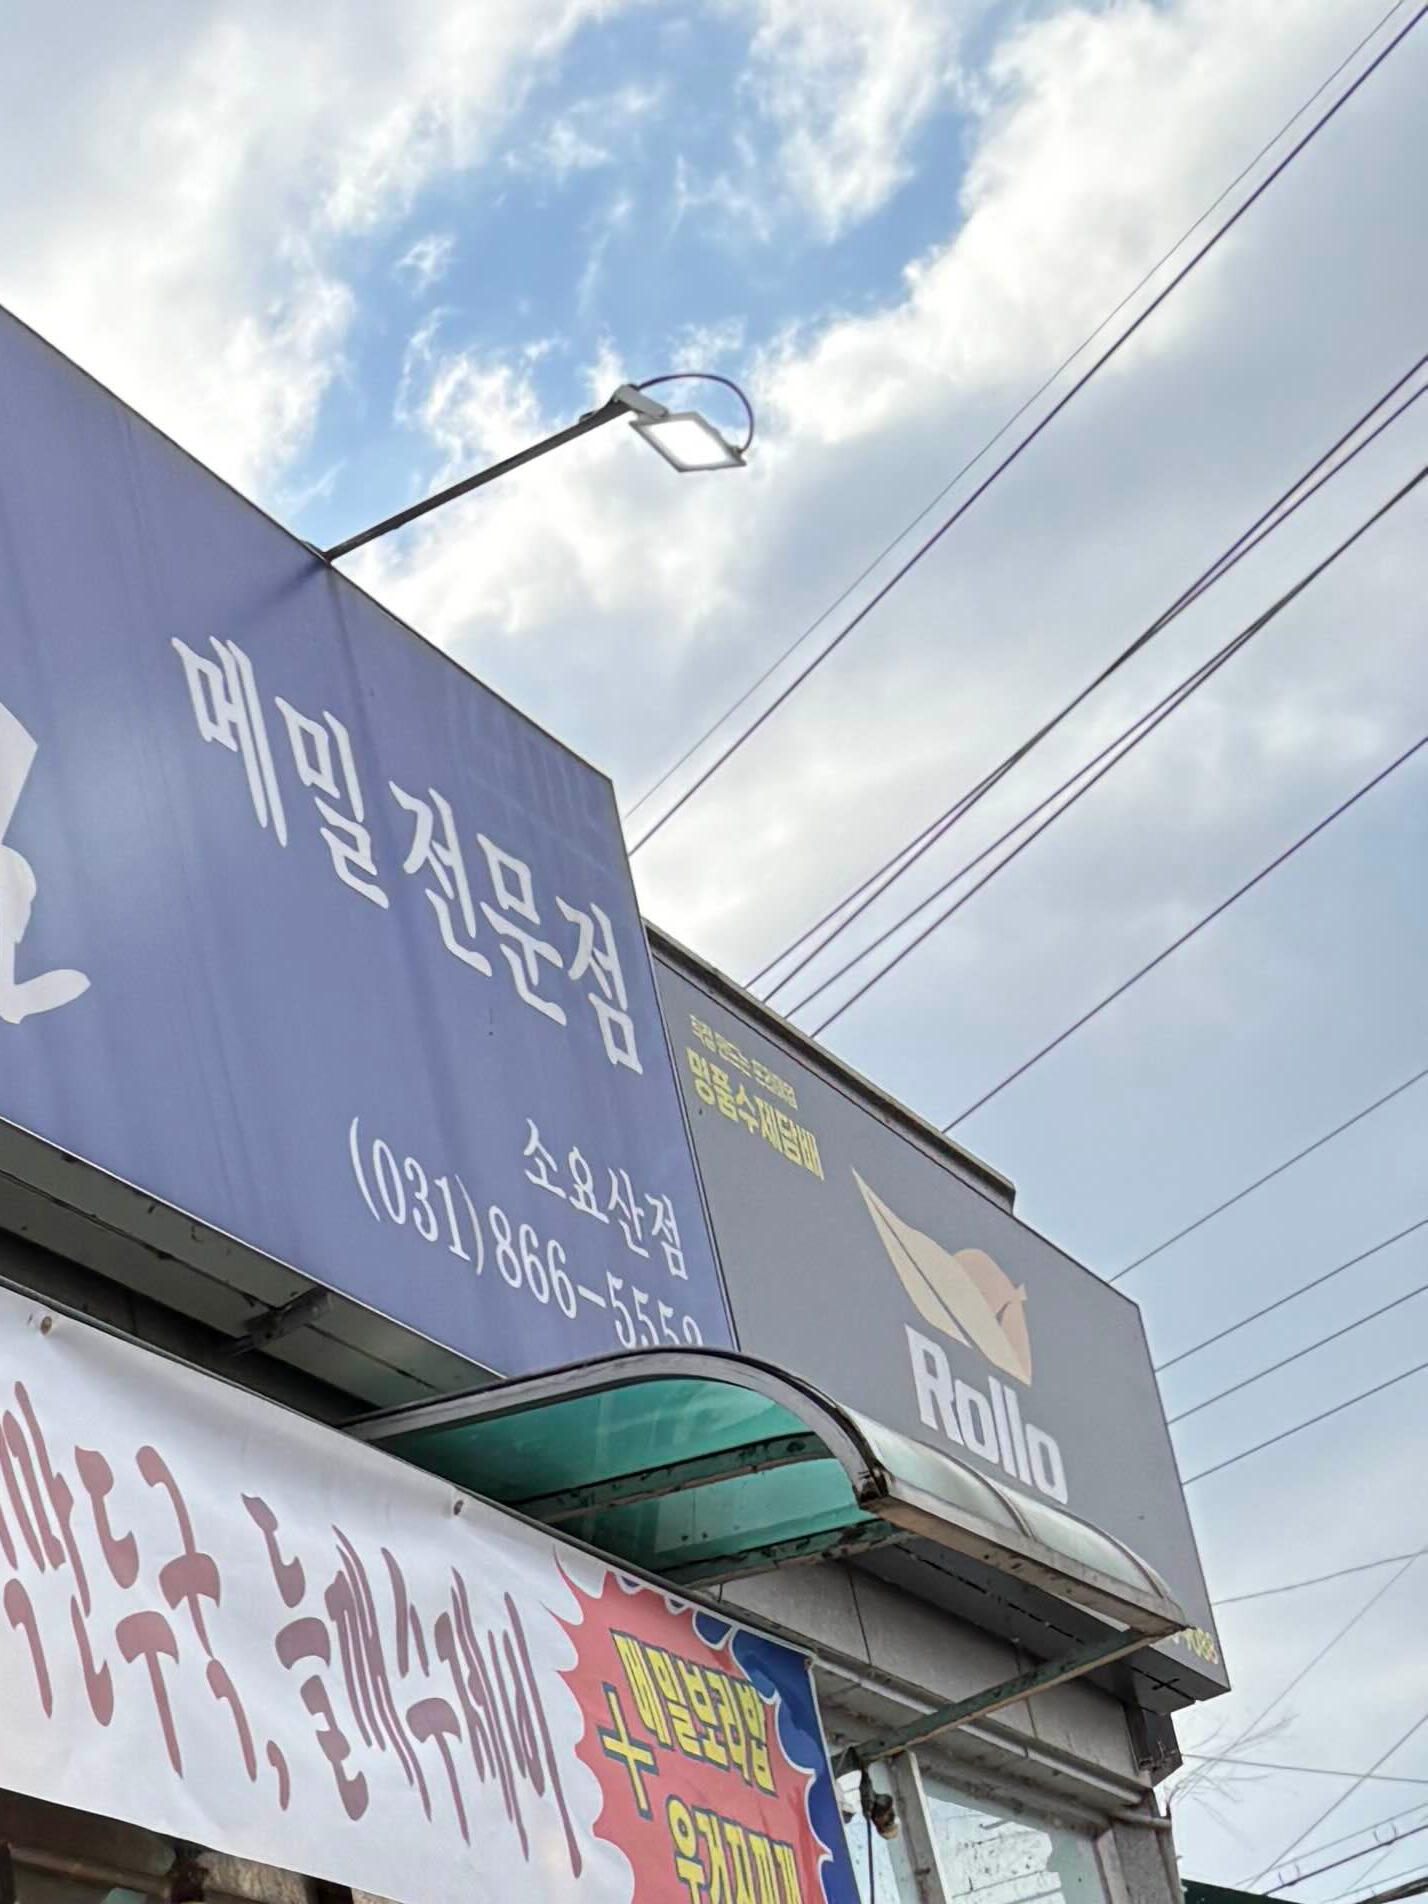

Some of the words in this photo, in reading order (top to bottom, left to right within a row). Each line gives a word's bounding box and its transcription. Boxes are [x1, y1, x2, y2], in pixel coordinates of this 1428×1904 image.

[686, 1047, 825, 1181] 명품수제담배
[524, 1118, 689, 1280] 소요산점
[904, 1323, 1069, 1505] Rollo
